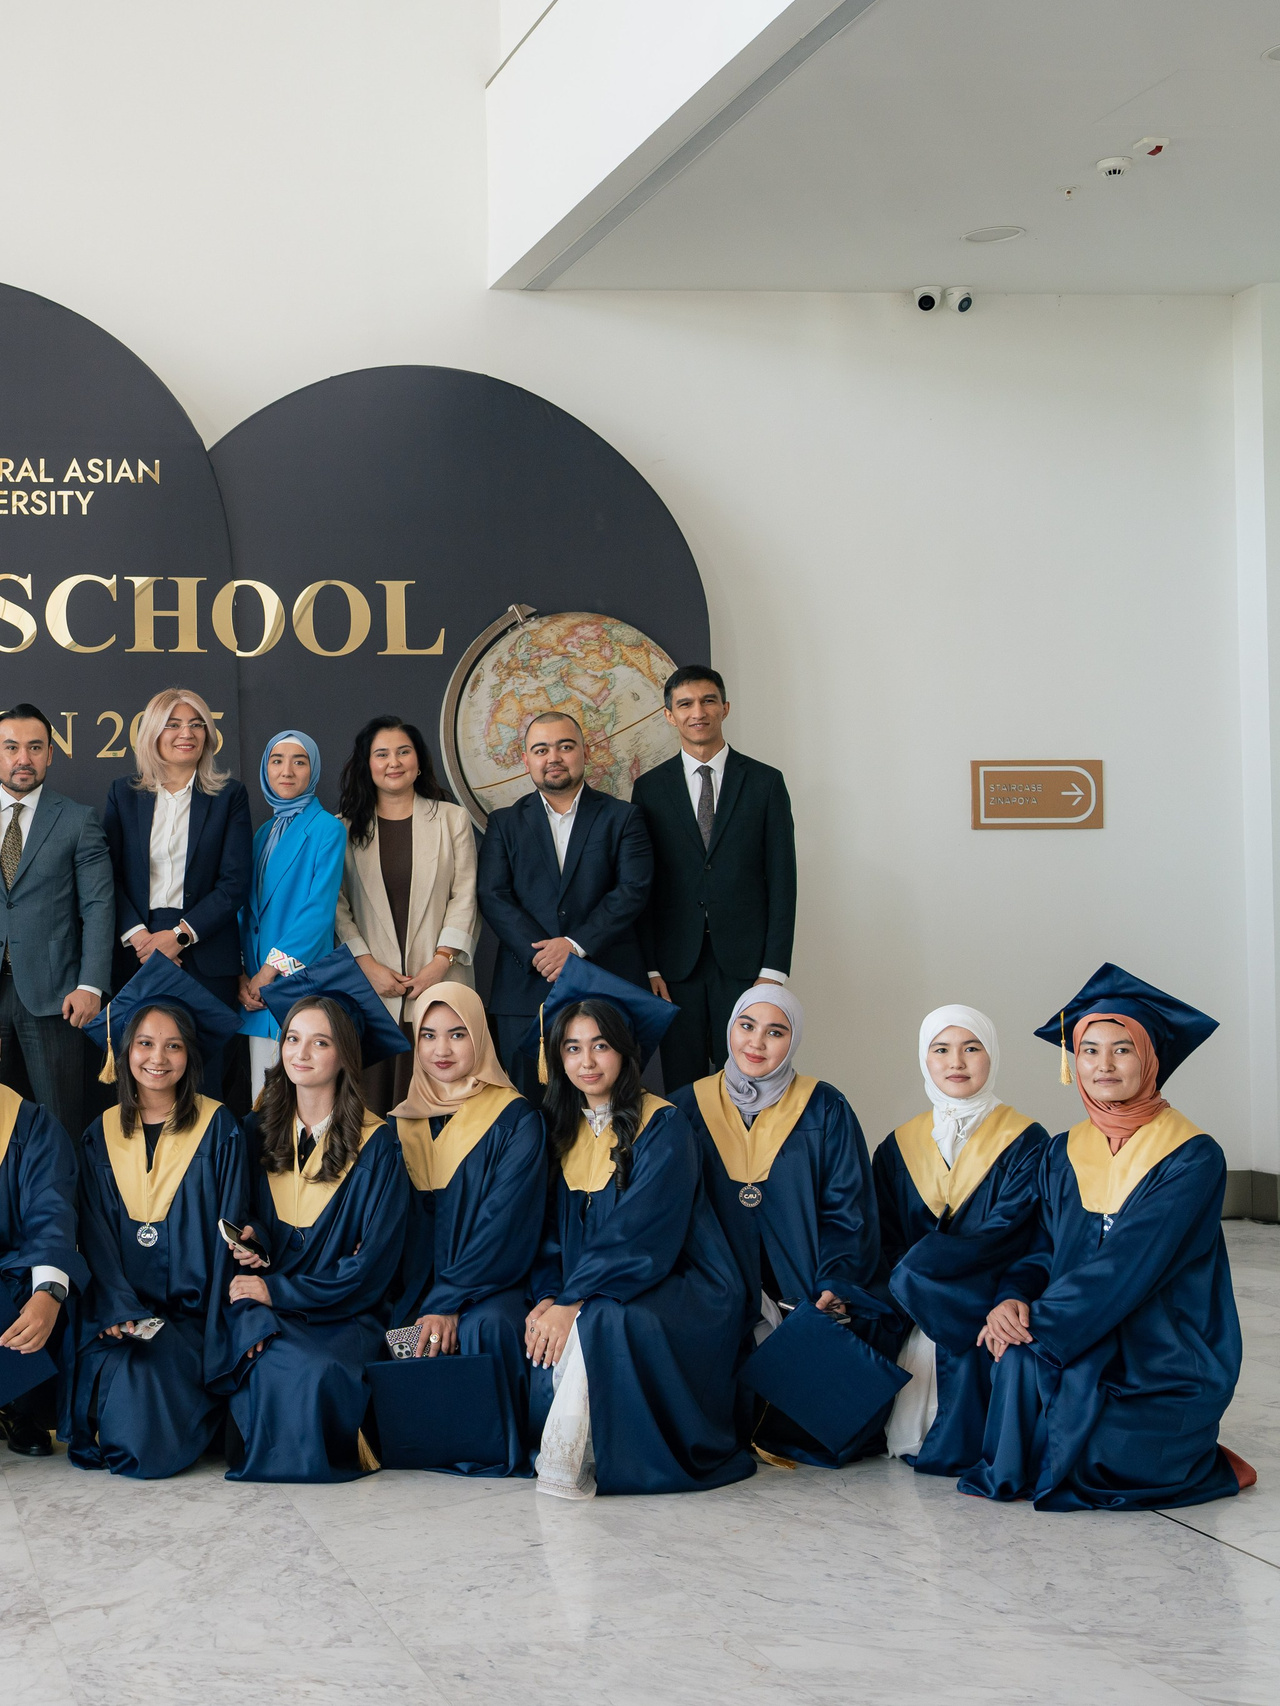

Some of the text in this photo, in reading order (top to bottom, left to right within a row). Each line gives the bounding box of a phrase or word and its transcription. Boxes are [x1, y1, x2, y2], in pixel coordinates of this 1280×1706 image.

[62, 458, 161, 485] ASIAN
[989, 783, 1042, 792] STAIRCASE
[989, 797, 1037, 805] ZINAPOYA
